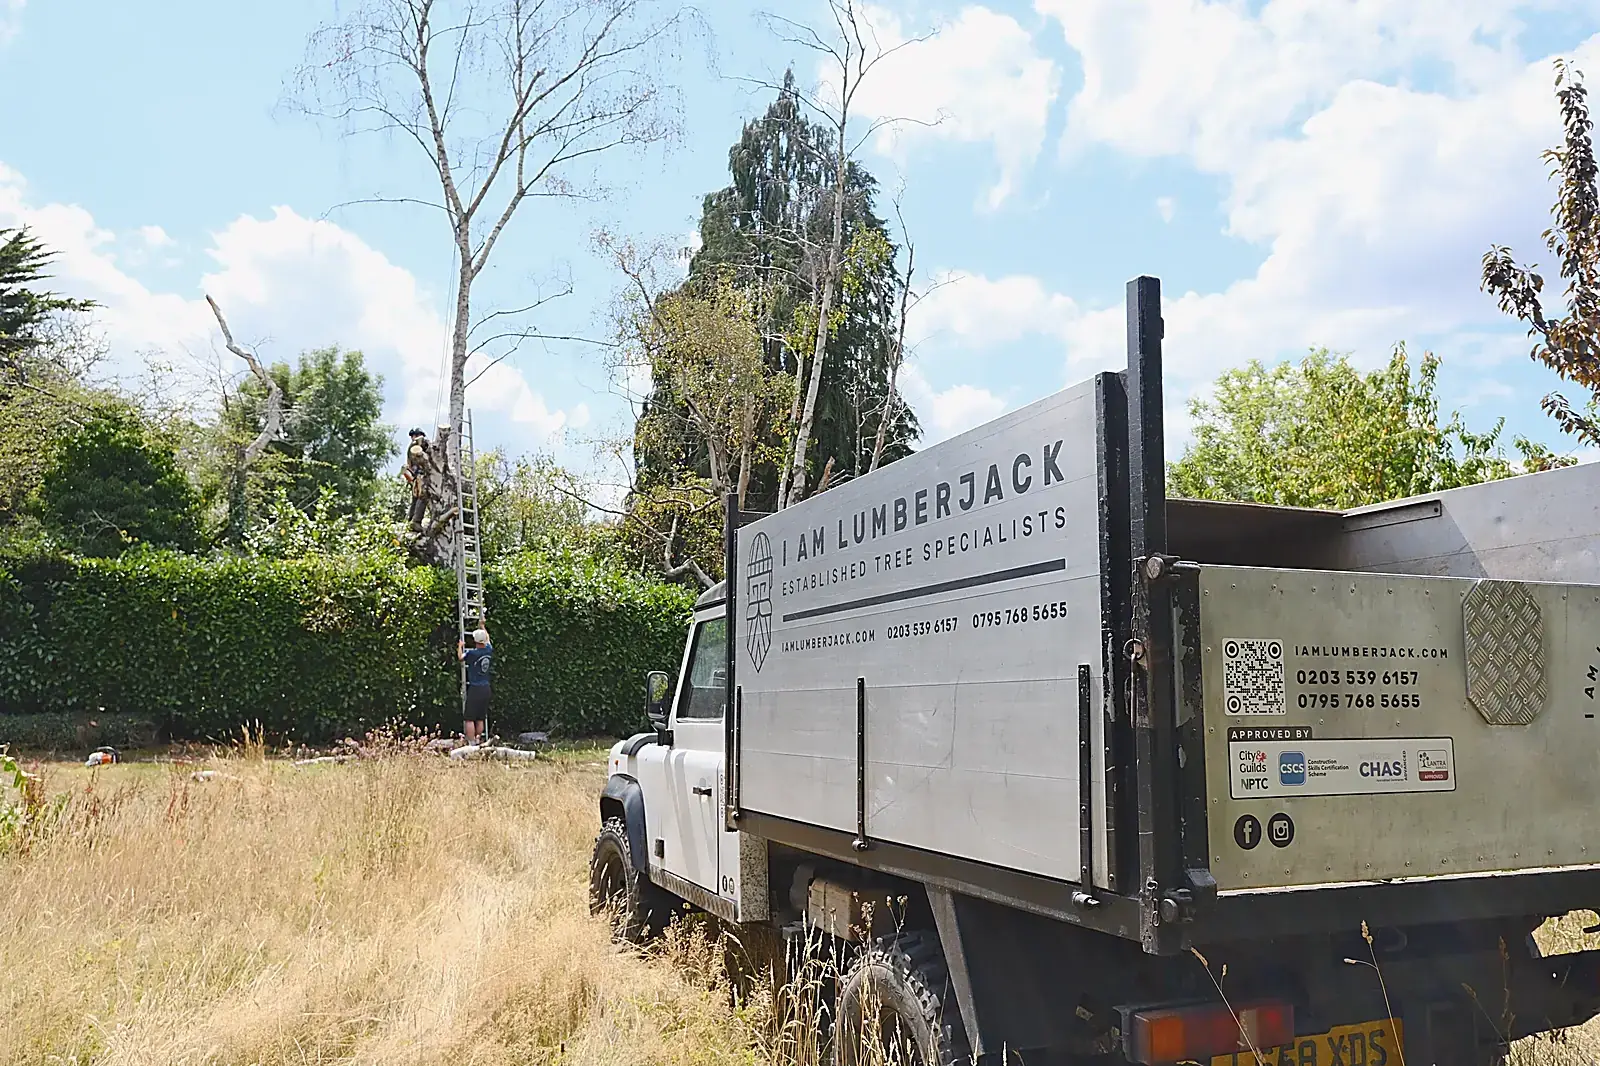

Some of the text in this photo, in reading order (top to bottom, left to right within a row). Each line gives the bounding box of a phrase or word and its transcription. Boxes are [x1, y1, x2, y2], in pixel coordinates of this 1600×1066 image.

[782, 439, 1065, 567] I AM LUMBERJACK
[782, 506, 1067, 596] ESTABLISHED TREE SPECIALISTS
[781, 601, 1068, 653] IAMLUMBERJACK.COM 0203 539 6157 0795 768 5655
[1295, 645, 1449, 659] IAMLUMBERJACK.COM
[1296, 670, 1419, 685] 0203 539 6157
[1584, 664, 1599, 700] AM
[1298, 694, 1421, 708] 0795 768 5655
[1231, 729, 1310, 740] APPROVED BY
[1239, 763, 1267, 773] Guilds
[1280, 763, 1305, 774] CSCS
[1359, 761, 1402, 778] CHAS
[1241, 777, 1269, 790] NPTC
